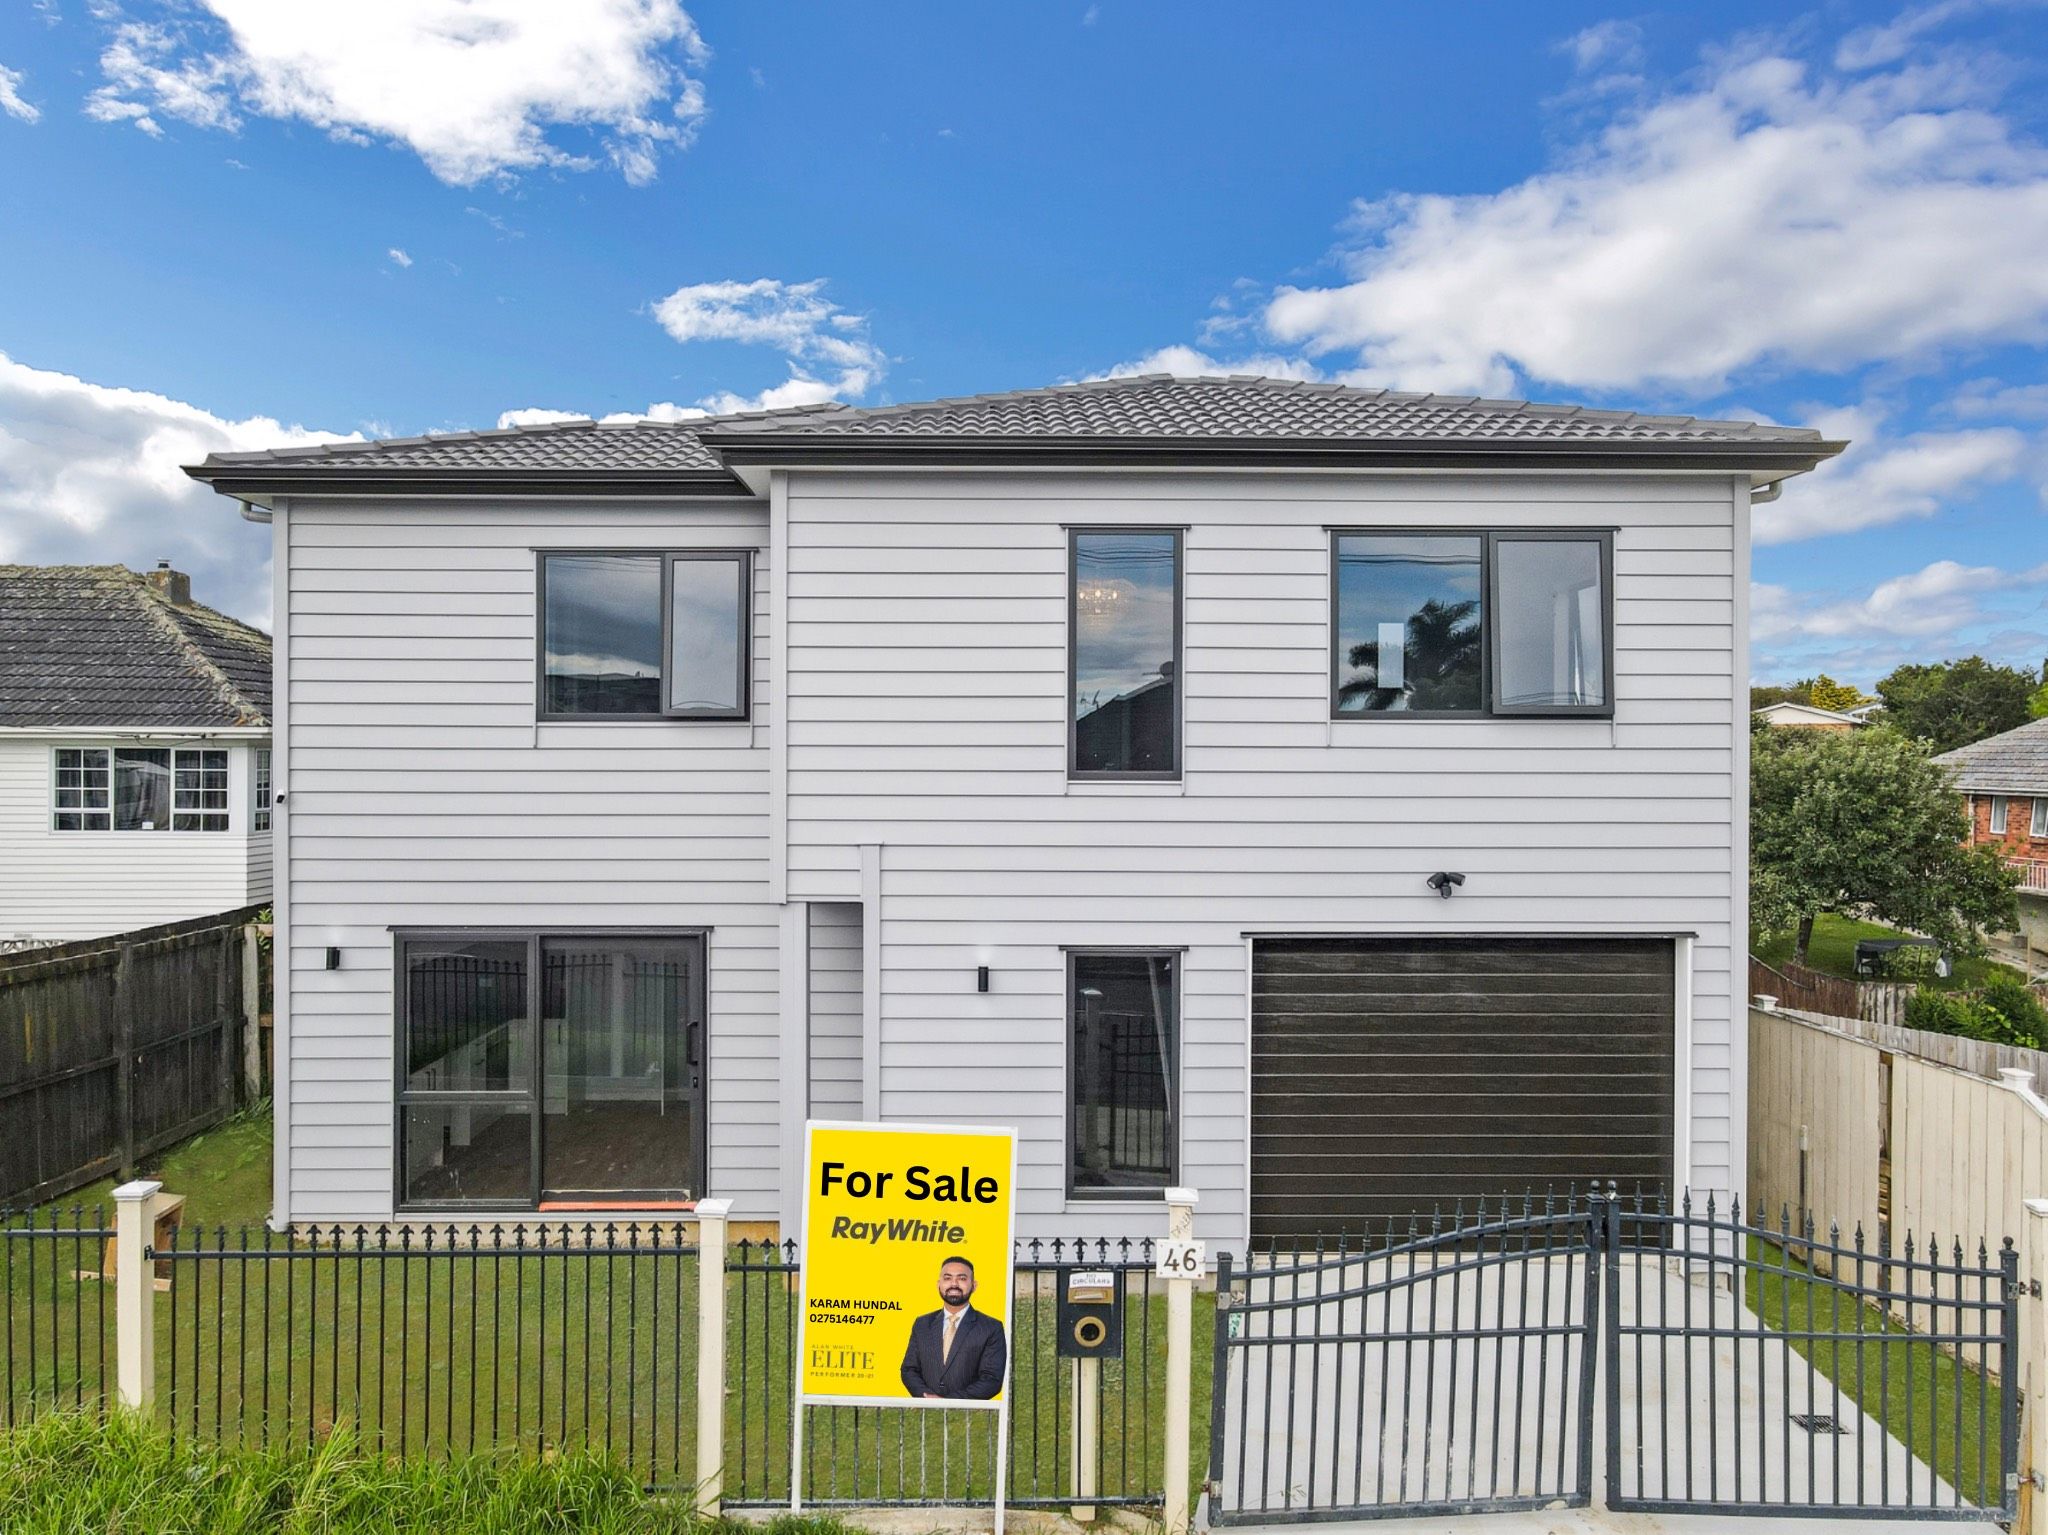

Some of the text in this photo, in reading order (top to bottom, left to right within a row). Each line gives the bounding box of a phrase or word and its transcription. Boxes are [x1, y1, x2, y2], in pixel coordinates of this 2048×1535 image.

[821, 1162, 998, 1204] For Sale
[1164, 1248, 1197, 1271] 46
[810, 1298, 902, 1310] KARAM HUNDAL
[809, 1313, 875, 1325] 0275146477
[810, 1350, 875, 1370] ELITE
